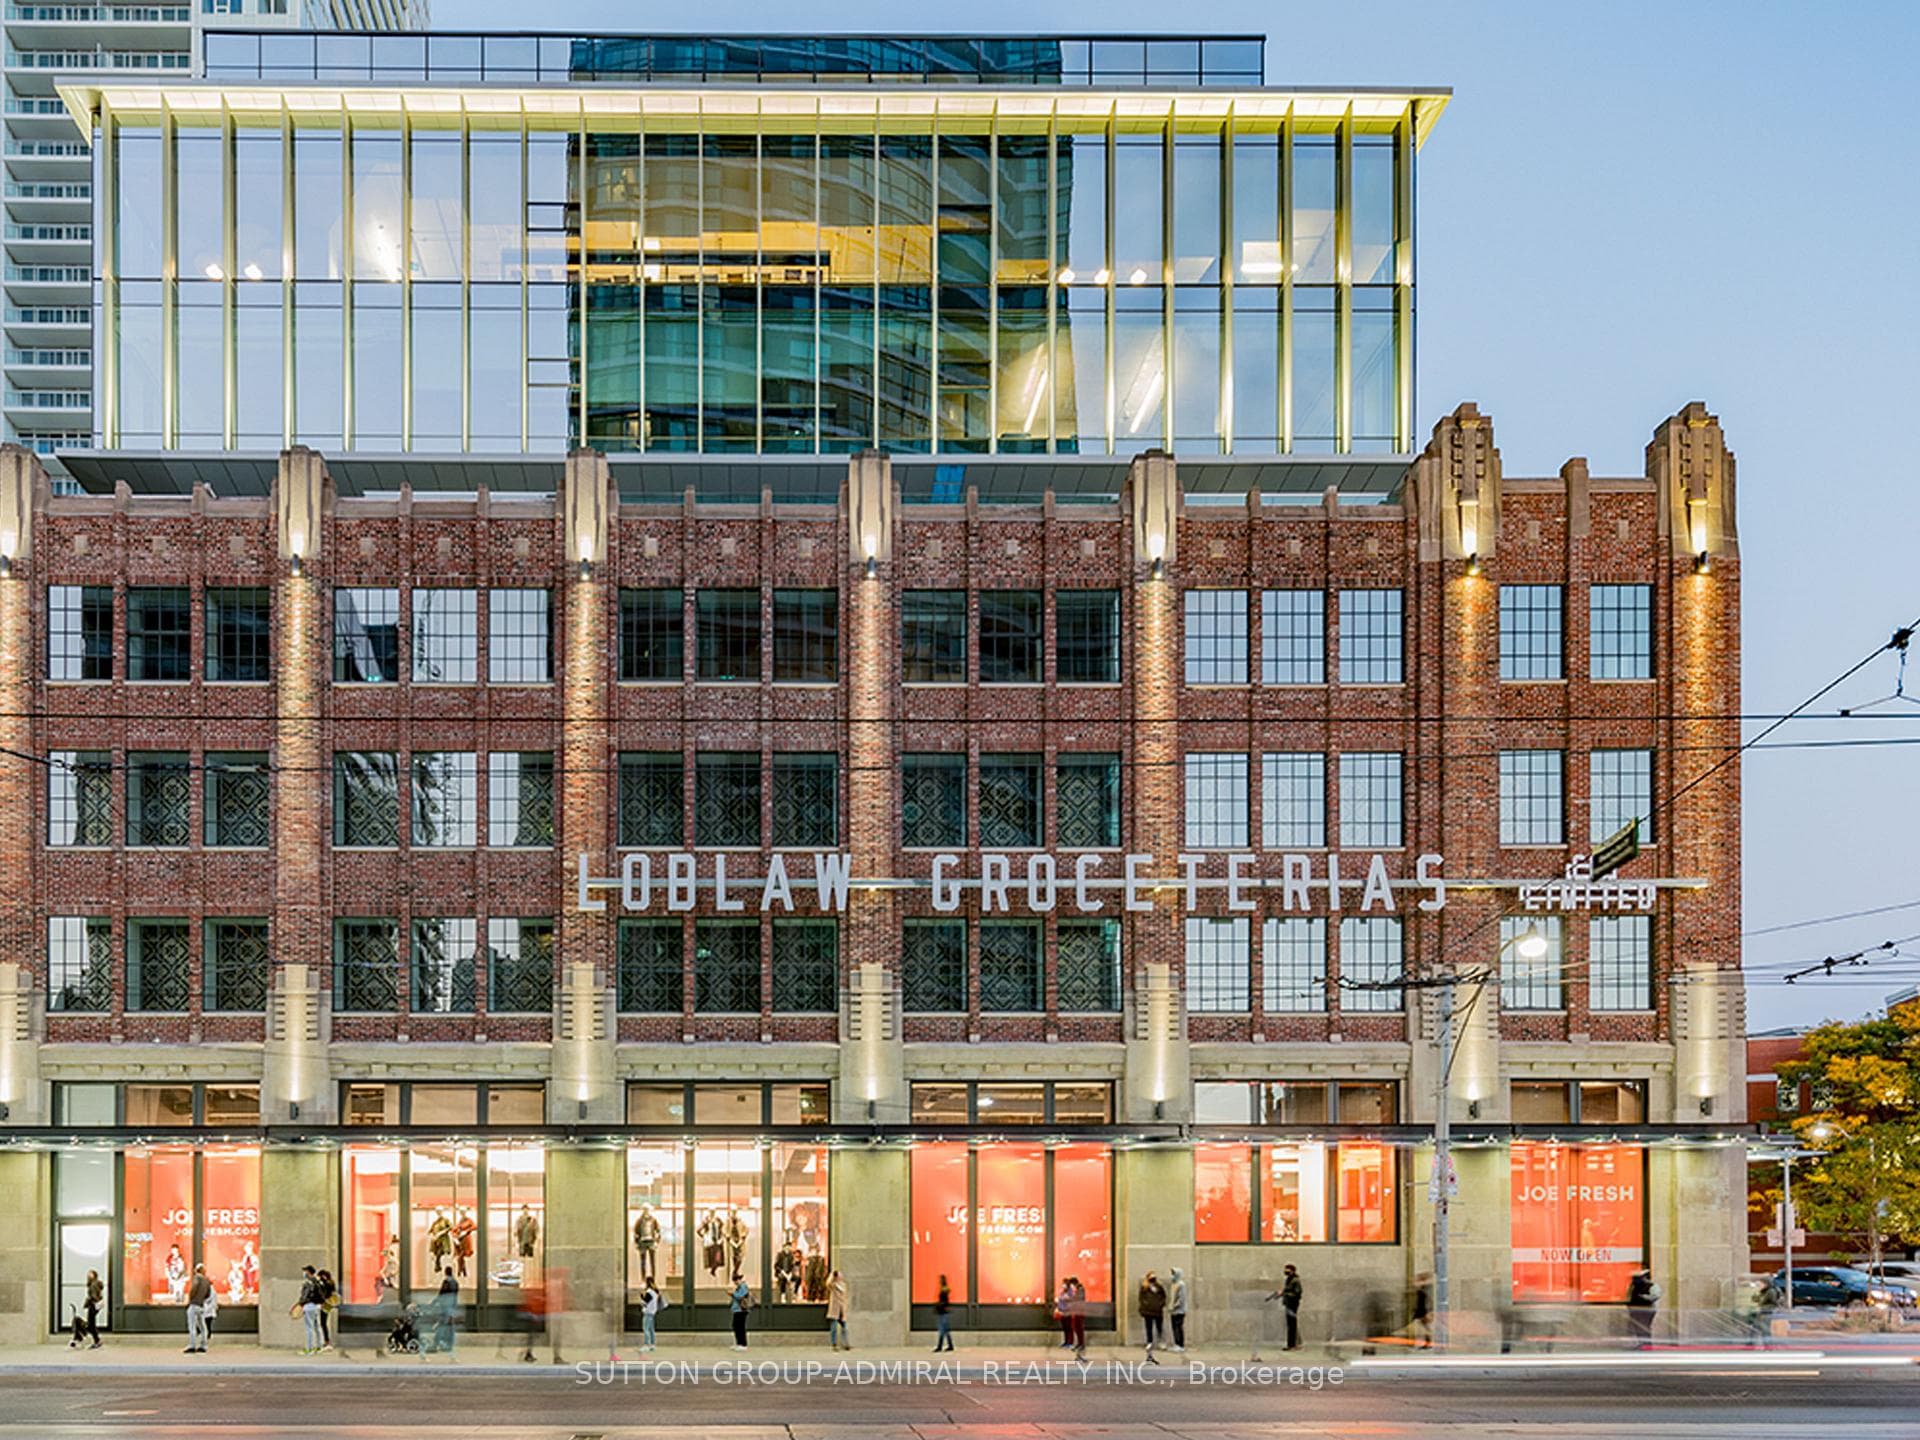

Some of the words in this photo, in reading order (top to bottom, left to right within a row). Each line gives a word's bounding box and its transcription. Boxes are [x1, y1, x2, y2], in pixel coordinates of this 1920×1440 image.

[578, 853, 851, 911] LOBLAW
[932, 854, 1447, 911] GROCETERIAS
[1517, 1185, 1558, 1201] JOE
[1567, 1185, 1634, 1201] FRESH
[208, 1209, 260, 1225] FRES
[992, 1207, 1046, 1223] FRES
[1541, 1249, 1572, 1261] NOW
[1577, 1249, 1612, 1261] OPEN
